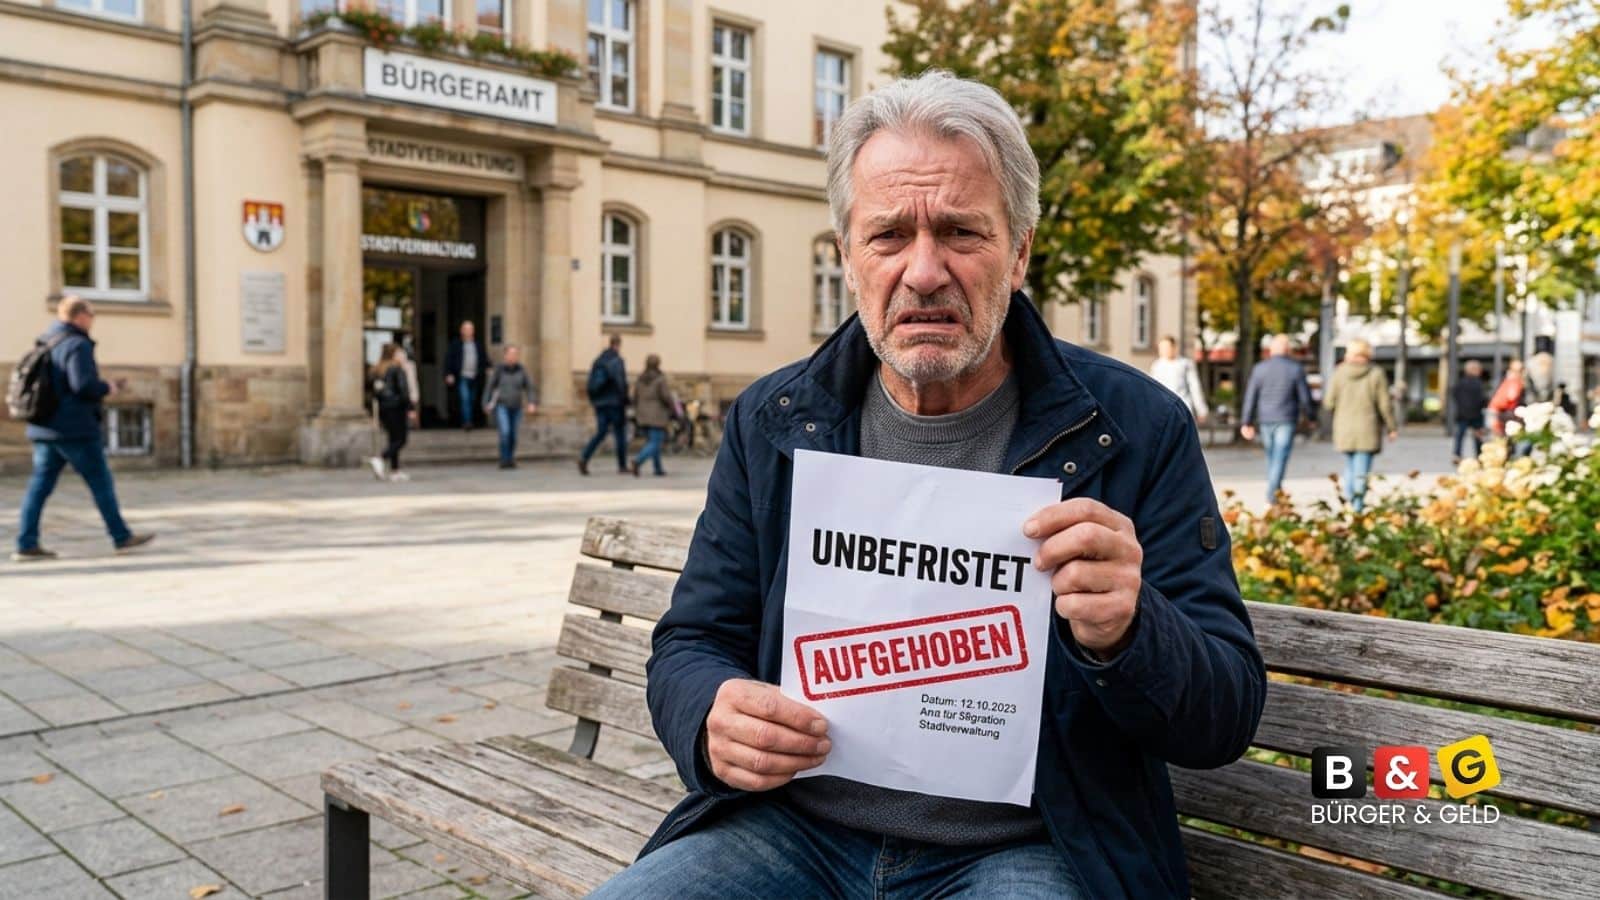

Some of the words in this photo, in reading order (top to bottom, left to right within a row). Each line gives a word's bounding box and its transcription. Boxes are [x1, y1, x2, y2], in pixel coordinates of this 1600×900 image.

[382, 62, 544, 112] BÜRGERAMT
[367, 138, 515, 173] STADTVERWALTUNG
[360, 234, 477, 259] STADTVERWALTUNG
[812, 528, 1031, 592] UNBEFRISTET
[814, 622, 1013, 685] AUFGEHOBEN
[921, 694, 958, 707] Datum:
[961, 698, 1017, 714] 12.10.2023
